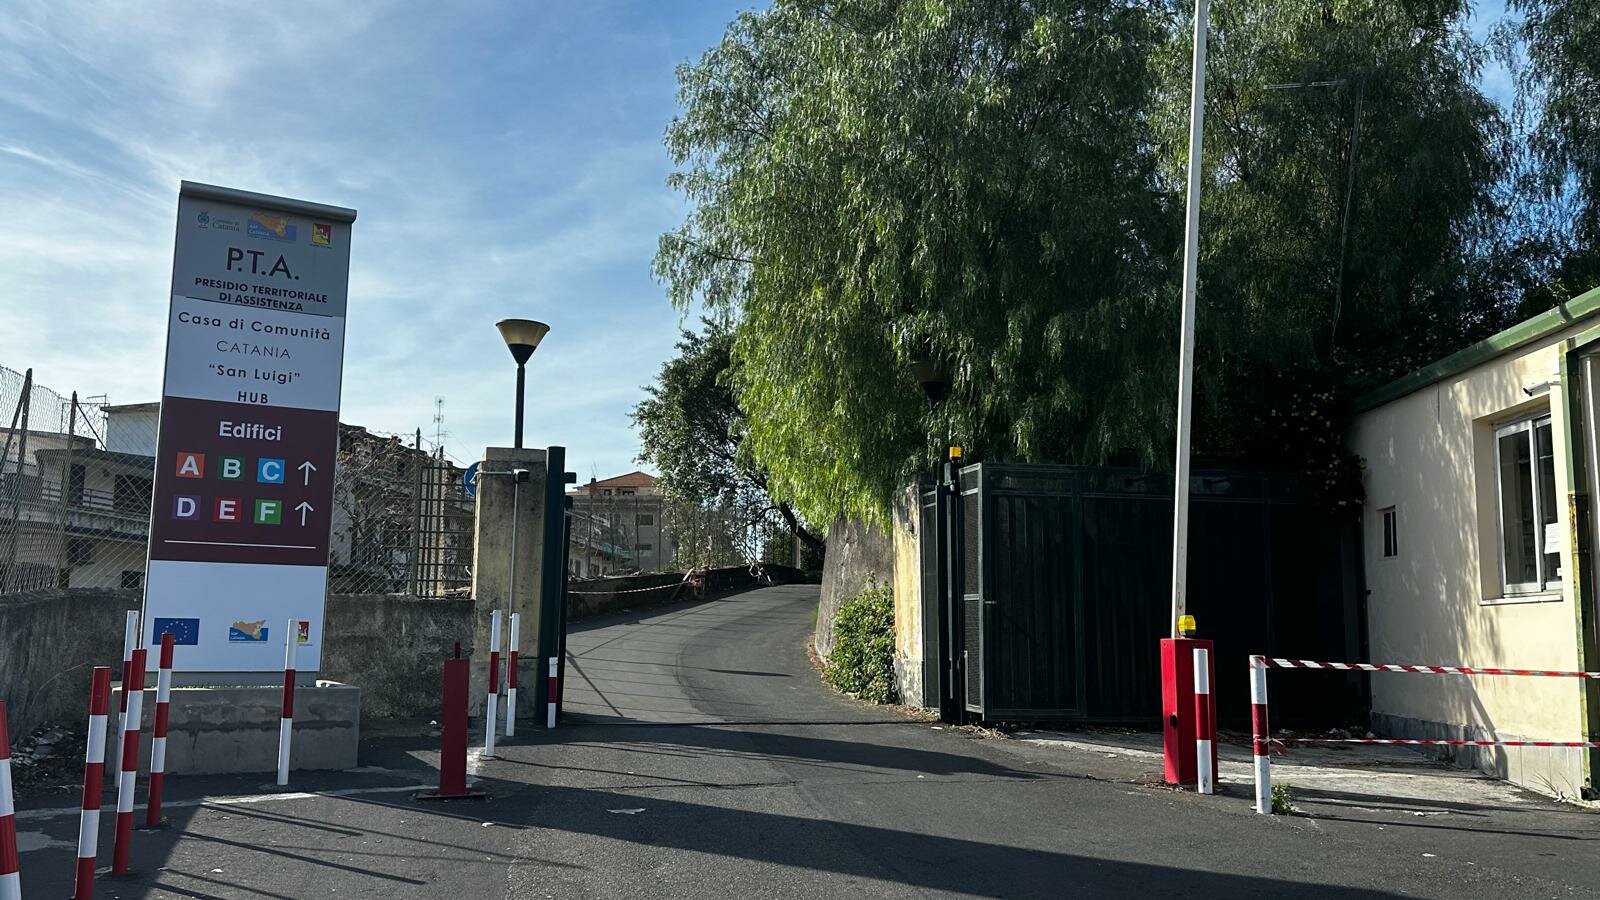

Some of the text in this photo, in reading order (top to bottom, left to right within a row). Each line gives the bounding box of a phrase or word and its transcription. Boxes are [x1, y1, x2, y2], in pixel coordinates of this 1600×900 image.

[226, 247, 300, 280] P.T.A.
[194, 277, 328, 303] PRESIDIO TERRITORIALE
[219, 292, 303, 311] DI ASSISTENZA
[178, 311, 330, 340] Casa di Comunità
[216, 340, 291, 359] CATANIA
[237, 391, 269, 404] HUB
[219, 420, 281, 441] Edifici
[179, 455, 280, 481] A B C
[176, 497, 276, 521] D E F
